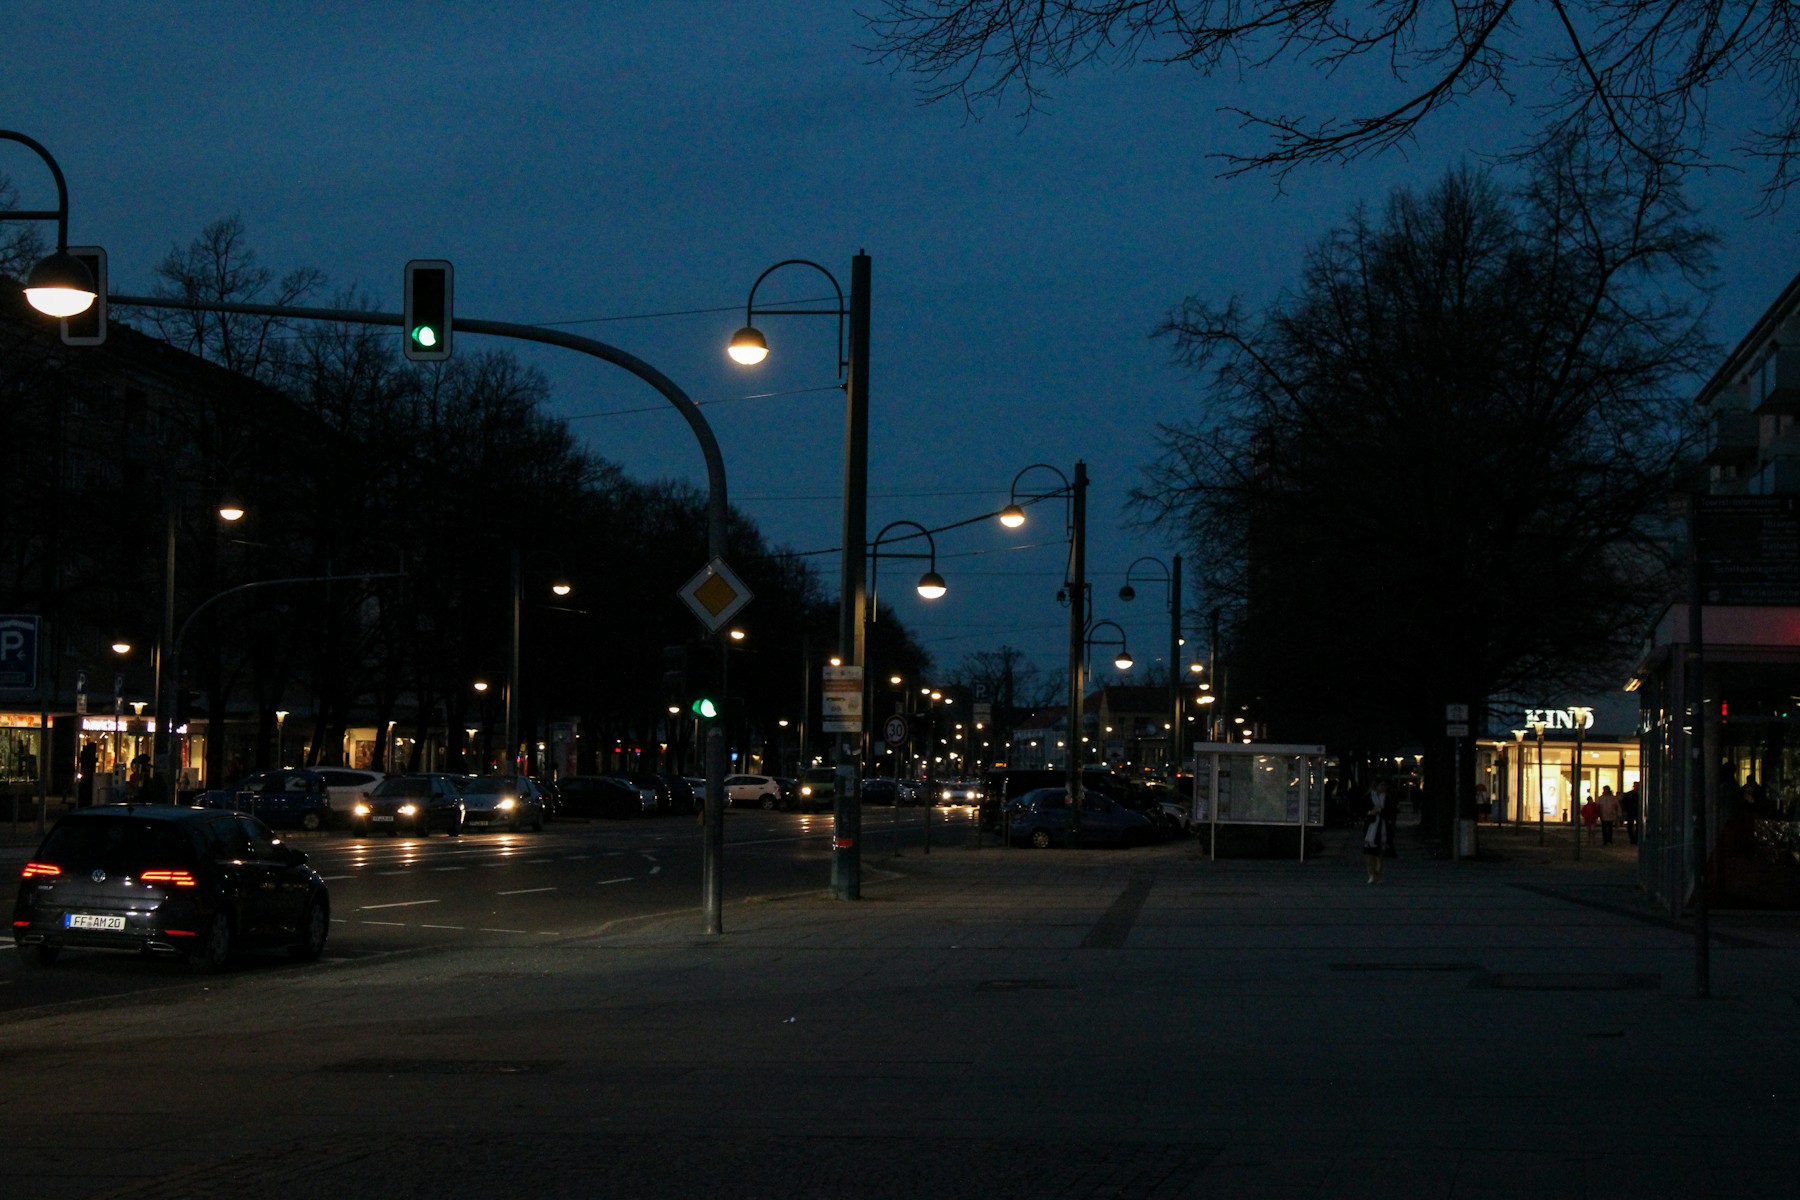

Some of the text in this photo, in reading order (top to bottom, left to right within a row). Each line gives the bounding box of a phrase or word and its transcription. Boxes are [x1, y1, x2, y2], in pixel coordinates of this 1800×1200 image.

[1, 631, 24, 661] P
[976, 684, 986, 699] P
[1524, 709, 1594, 729] KIND
[889, 724, 903, 737] 30
[74, 916, 121, 928] FF AM 20
